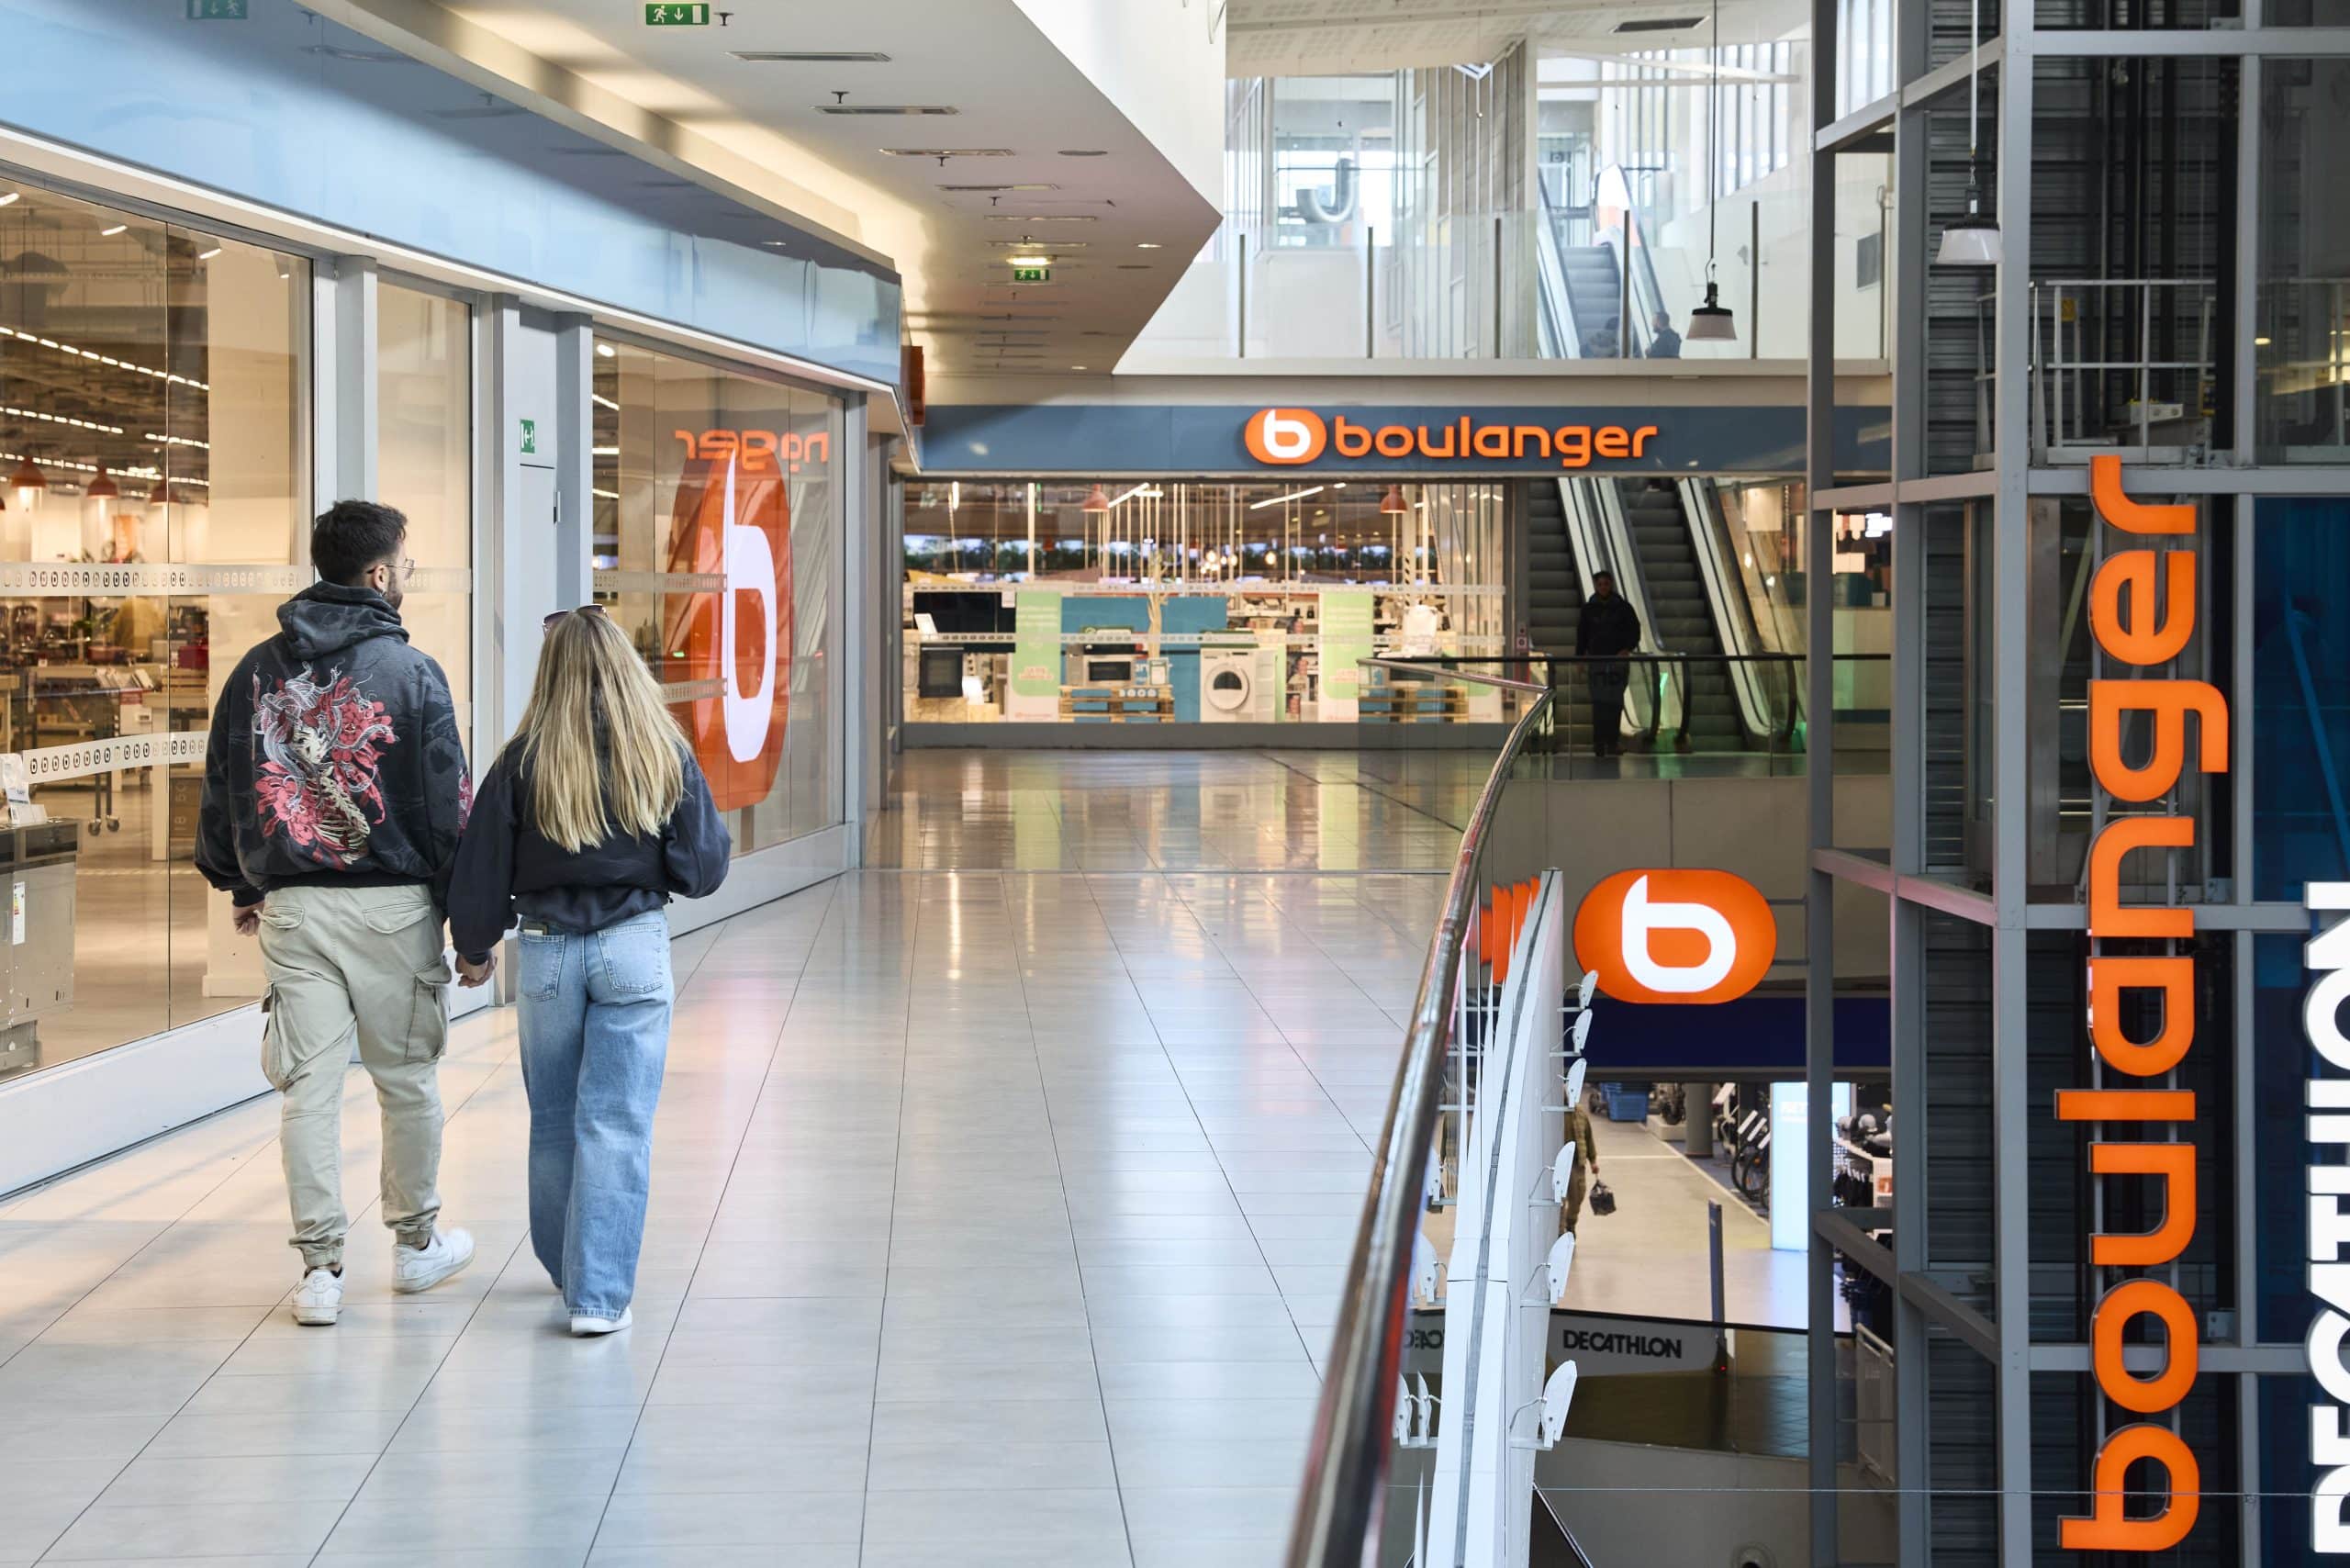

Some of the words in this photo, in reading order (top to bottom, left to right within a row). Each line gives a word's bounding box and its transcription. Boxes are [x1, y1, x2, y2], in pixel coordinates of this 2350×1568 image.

[1334, 415, 1658, 468] boulanger
[1622, 874, 1737, 993] b
[2055, 454, 2230, 1551] boulanger
[1562, 1329, 1682, 1359] DECATHLON
